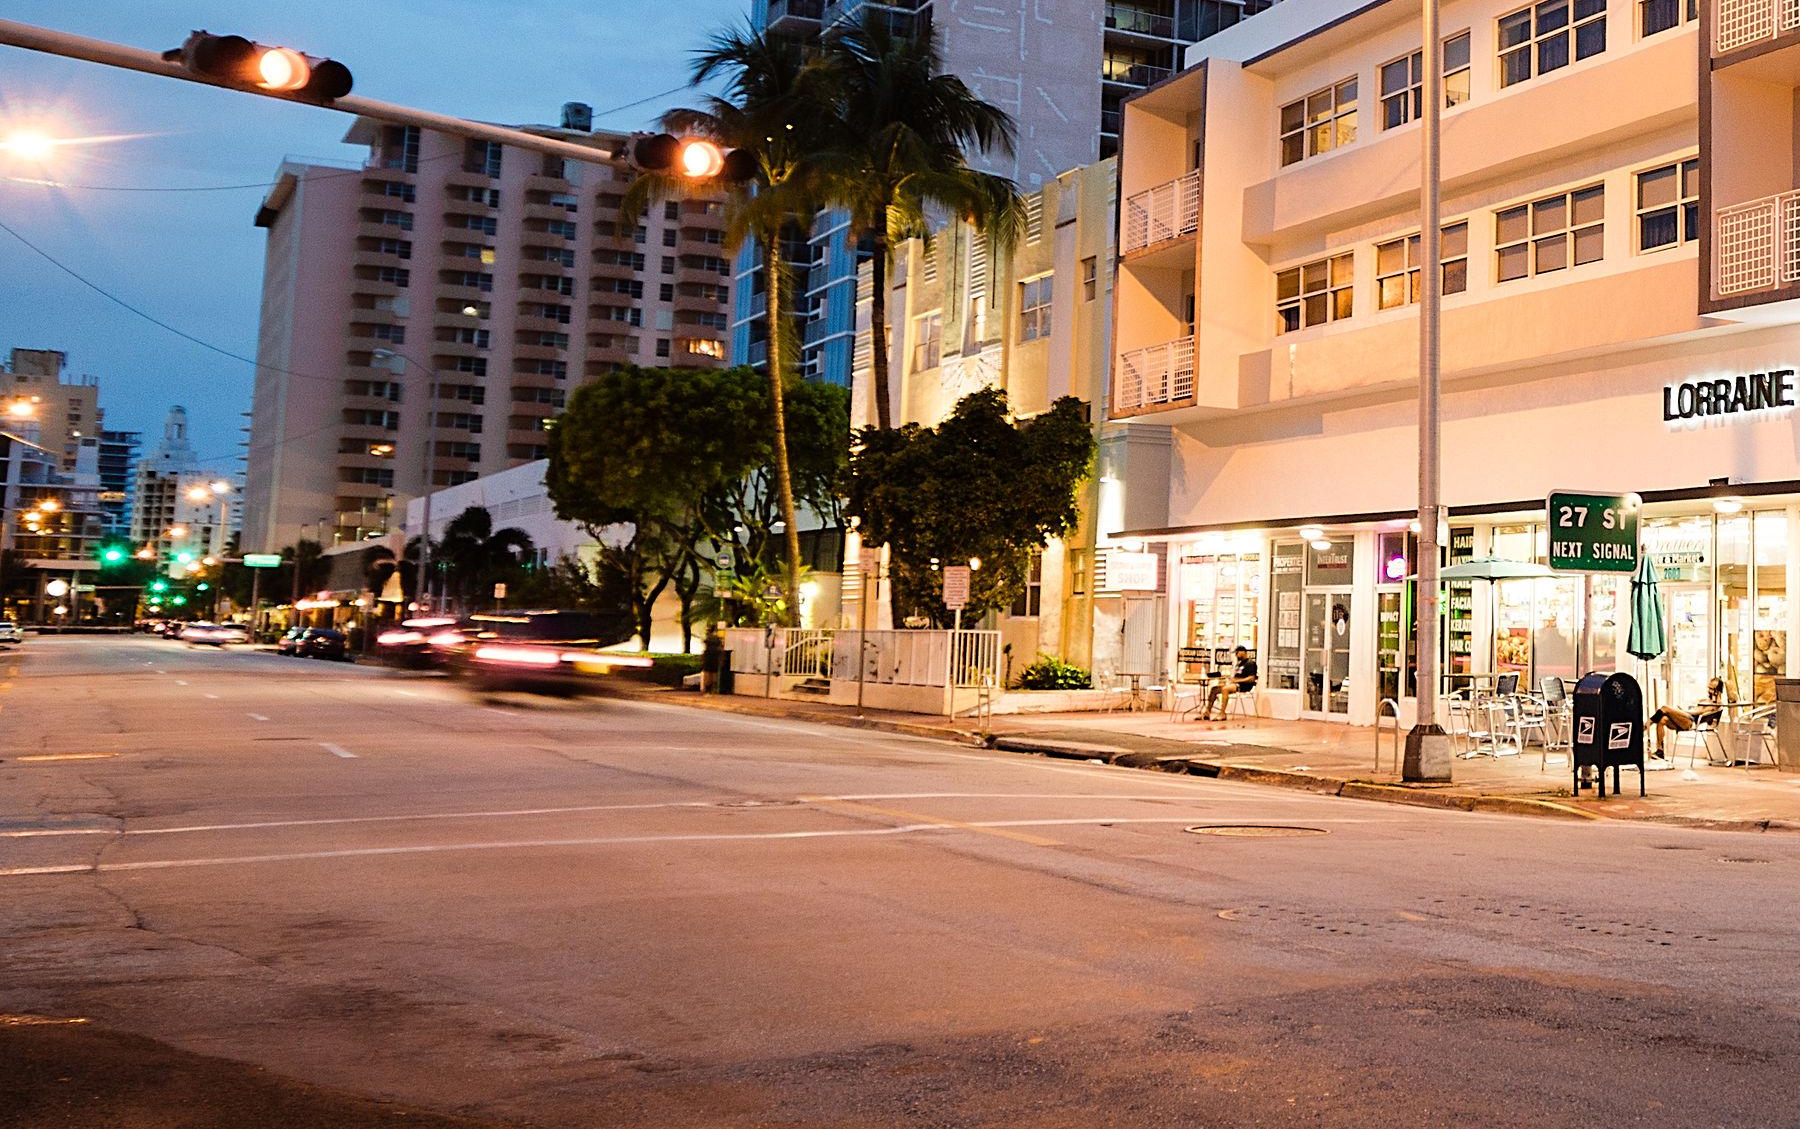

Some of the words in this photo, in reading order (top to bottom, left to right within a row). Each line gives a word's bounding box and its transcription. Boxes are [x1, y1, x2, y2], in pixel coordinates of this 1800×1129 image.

[1663, 370, 1795, 421] LORRAINE
[1559, 506, 1588, 528] 27
[1602, 507, 1630, 531] ST
[1552, 541, 1583, 558] NEXT
[1592, 542, 1634, 560] SIGNAL
[1117, 572, 1149, 585] SHOP
